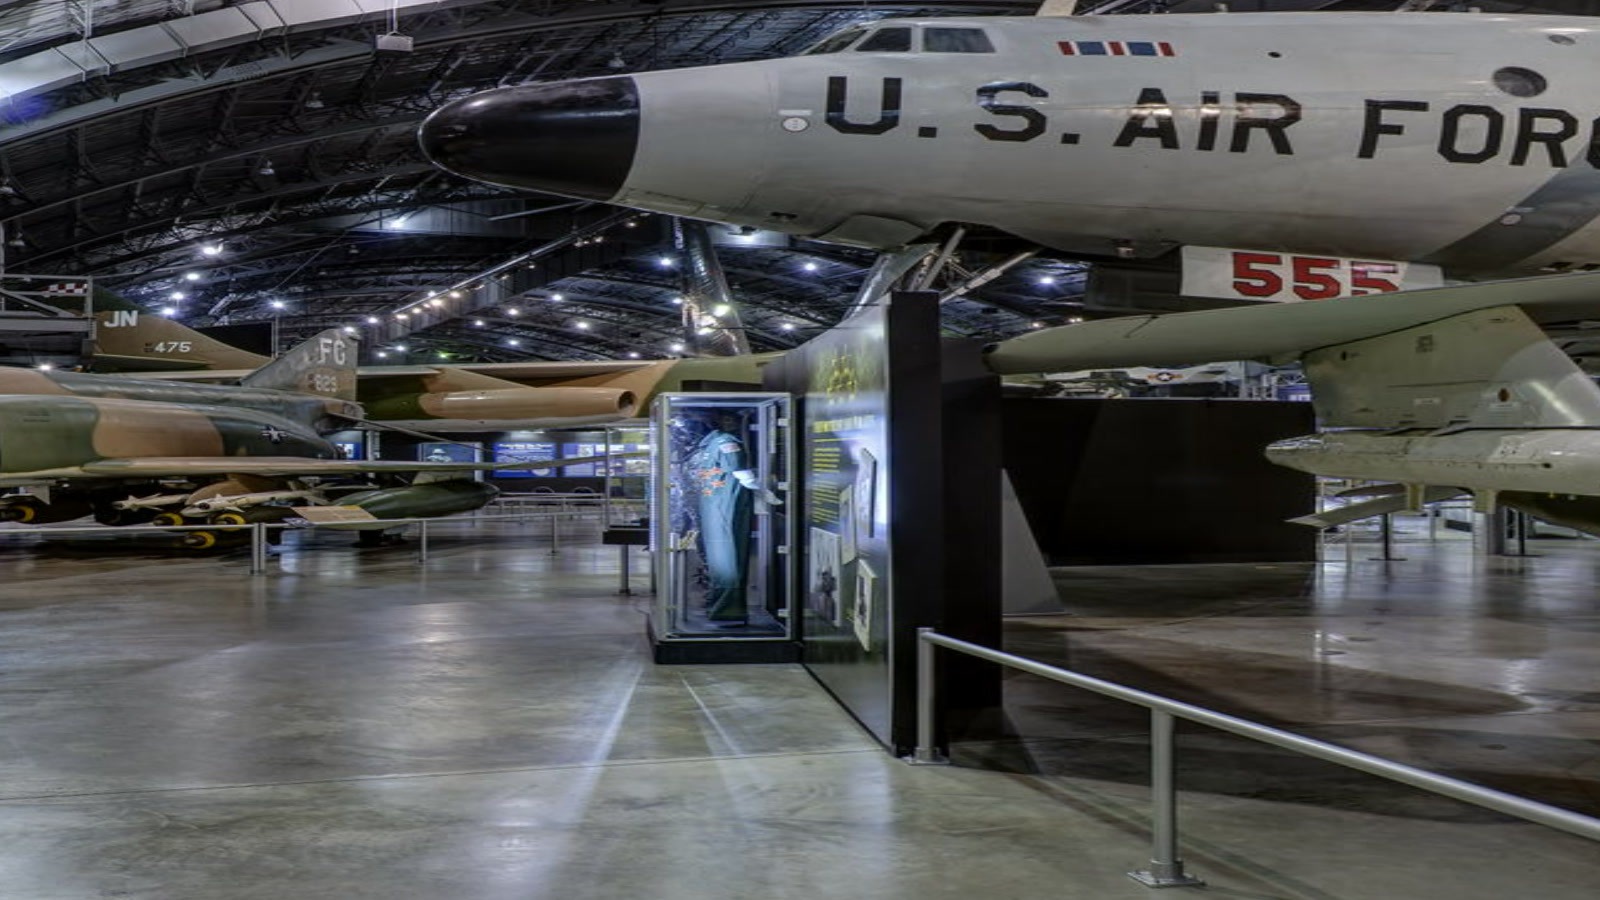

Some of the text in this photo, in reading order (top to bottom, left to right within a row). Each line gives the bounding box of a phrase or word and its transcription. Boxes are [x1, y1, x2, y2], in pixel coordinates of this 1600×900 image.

[1112, 87, 1302, 156] AIR
[1357, 99, 1600, 170] FOR
[1232, 251, 1400, 300] 555
[103, 309, 139, 328] JN
[154, 341, 193, 353] 475
[316, 337, 346, 366] FG
